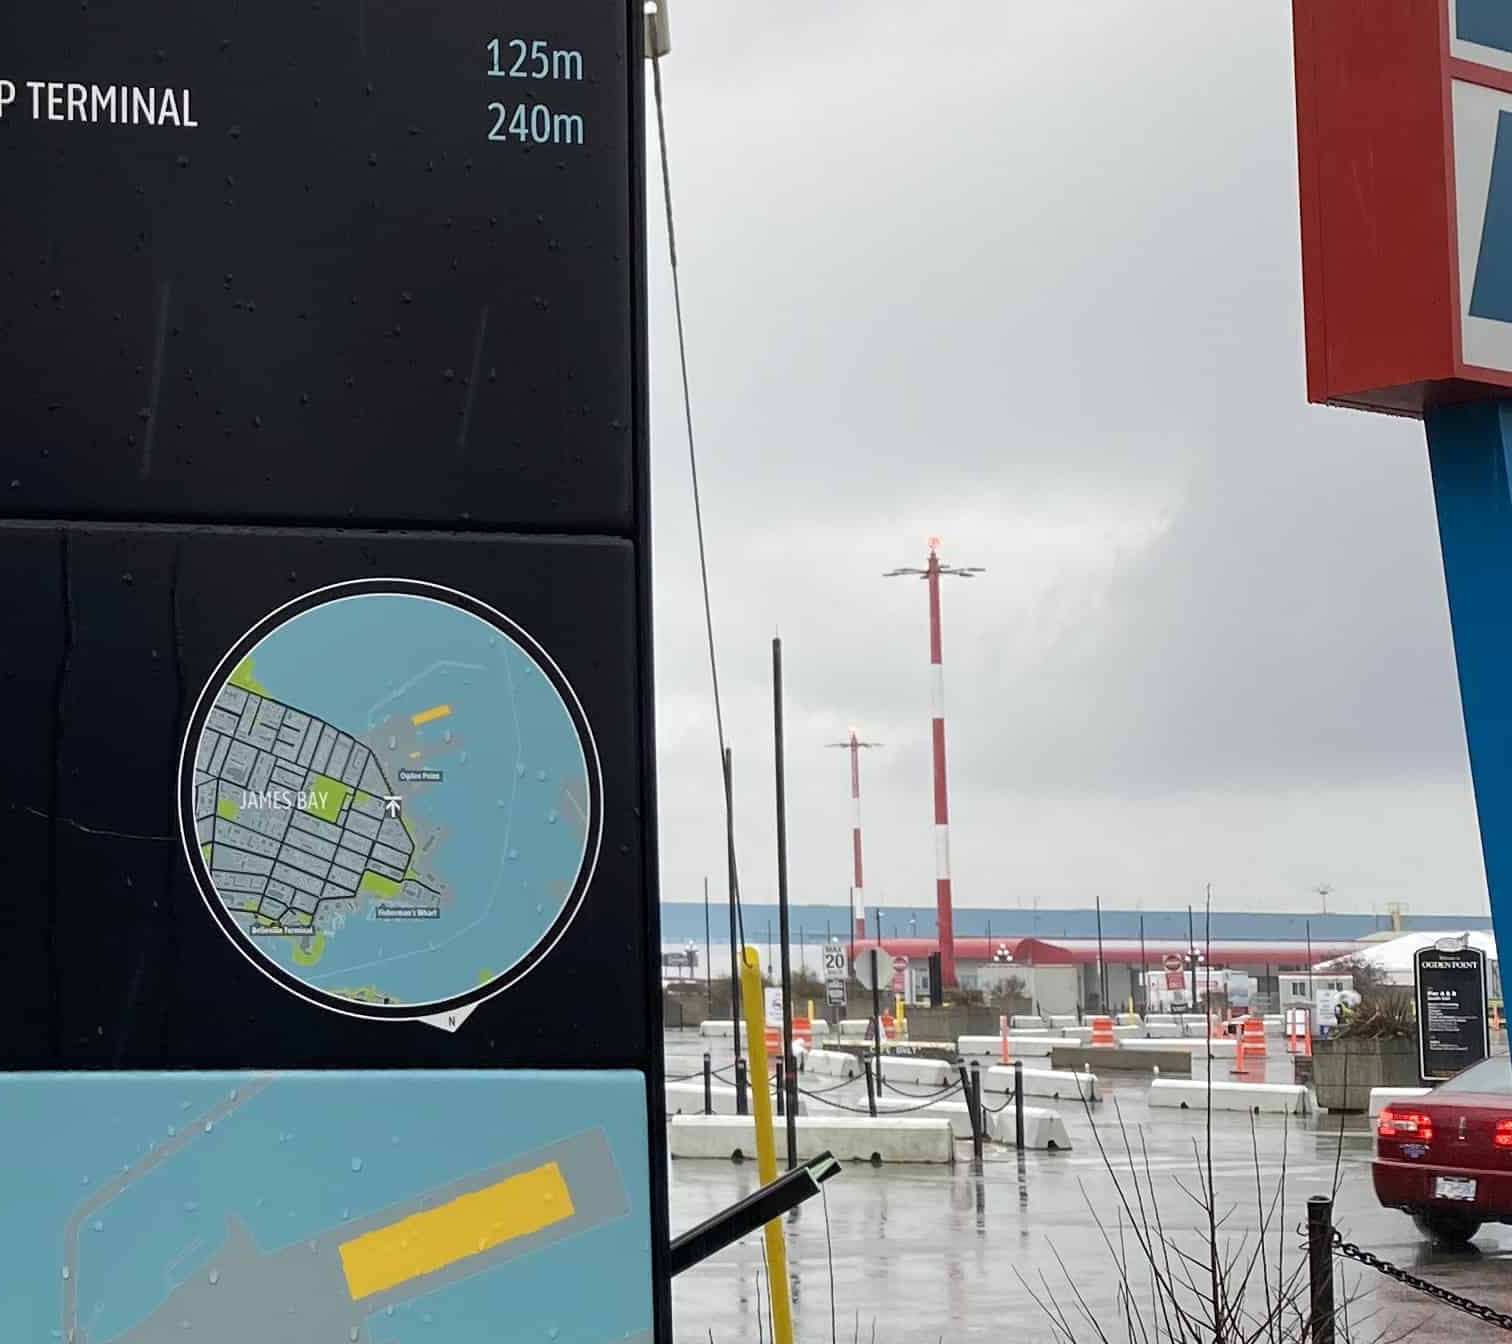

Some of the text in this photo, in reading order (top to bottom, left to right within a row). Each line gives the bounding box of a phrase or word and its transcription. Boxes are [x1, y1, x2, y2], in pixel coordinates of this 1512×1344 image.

[486, 40, 584, 81] 125m
[26, 82, 198, 129] TERMINAL
[487, 103, 585, 146] 240m
[240, 791, 328, 810] JAMES BAY
[825, 954, 844, 968] 20
[1421, 961, 1478, 969] OGDEN POINT
[448, 1015, 456, 1026] N
